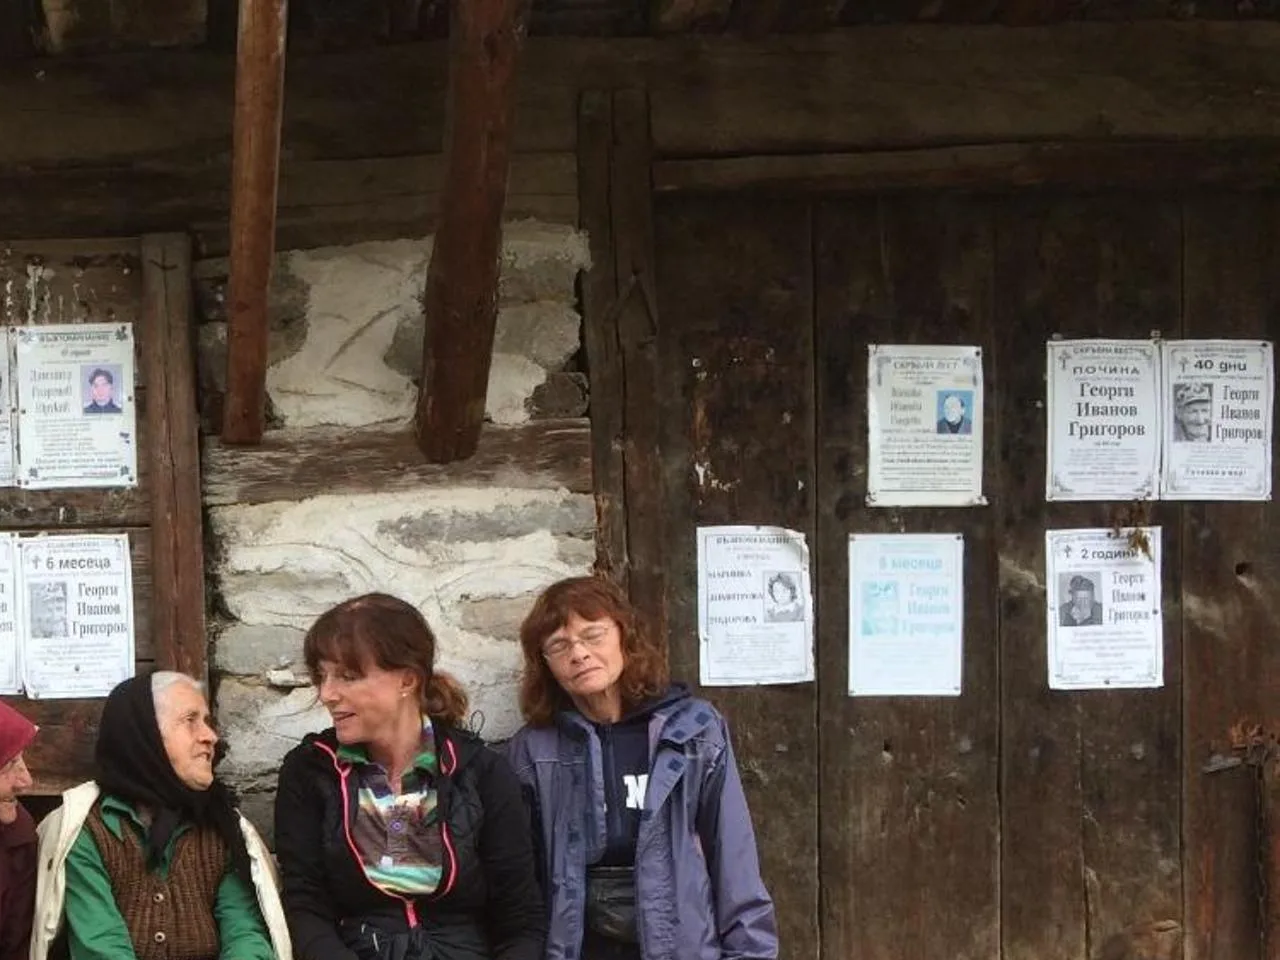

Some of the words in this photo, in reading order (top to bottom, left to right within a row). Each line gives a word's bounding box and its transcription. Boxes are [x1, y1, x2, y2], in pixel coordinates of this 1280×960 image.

[1073, 366, 1140, 375] ПОЧИНА
[1194, 359, 1214, 370] 40
[1079, 382, 1134, 400] Георги
[1223, 385, 1259, 404] Георги
[1076, 402, 1138, 417] Иванов
[1221, 404, 1260, 420] Иванов
[1068, 421, 1146, 439] Григоров
[1216, 424, 1263, 443] Григоров
[1081, 548, 1089, 559] 2
[46, 558, 54, 569] 6
[59, 558, 111, 570] месеца
[78, 582, 118, 599] Георги
[77, 602, 121, 616] Иванов
[72, 622, 127, 638] Григоров
